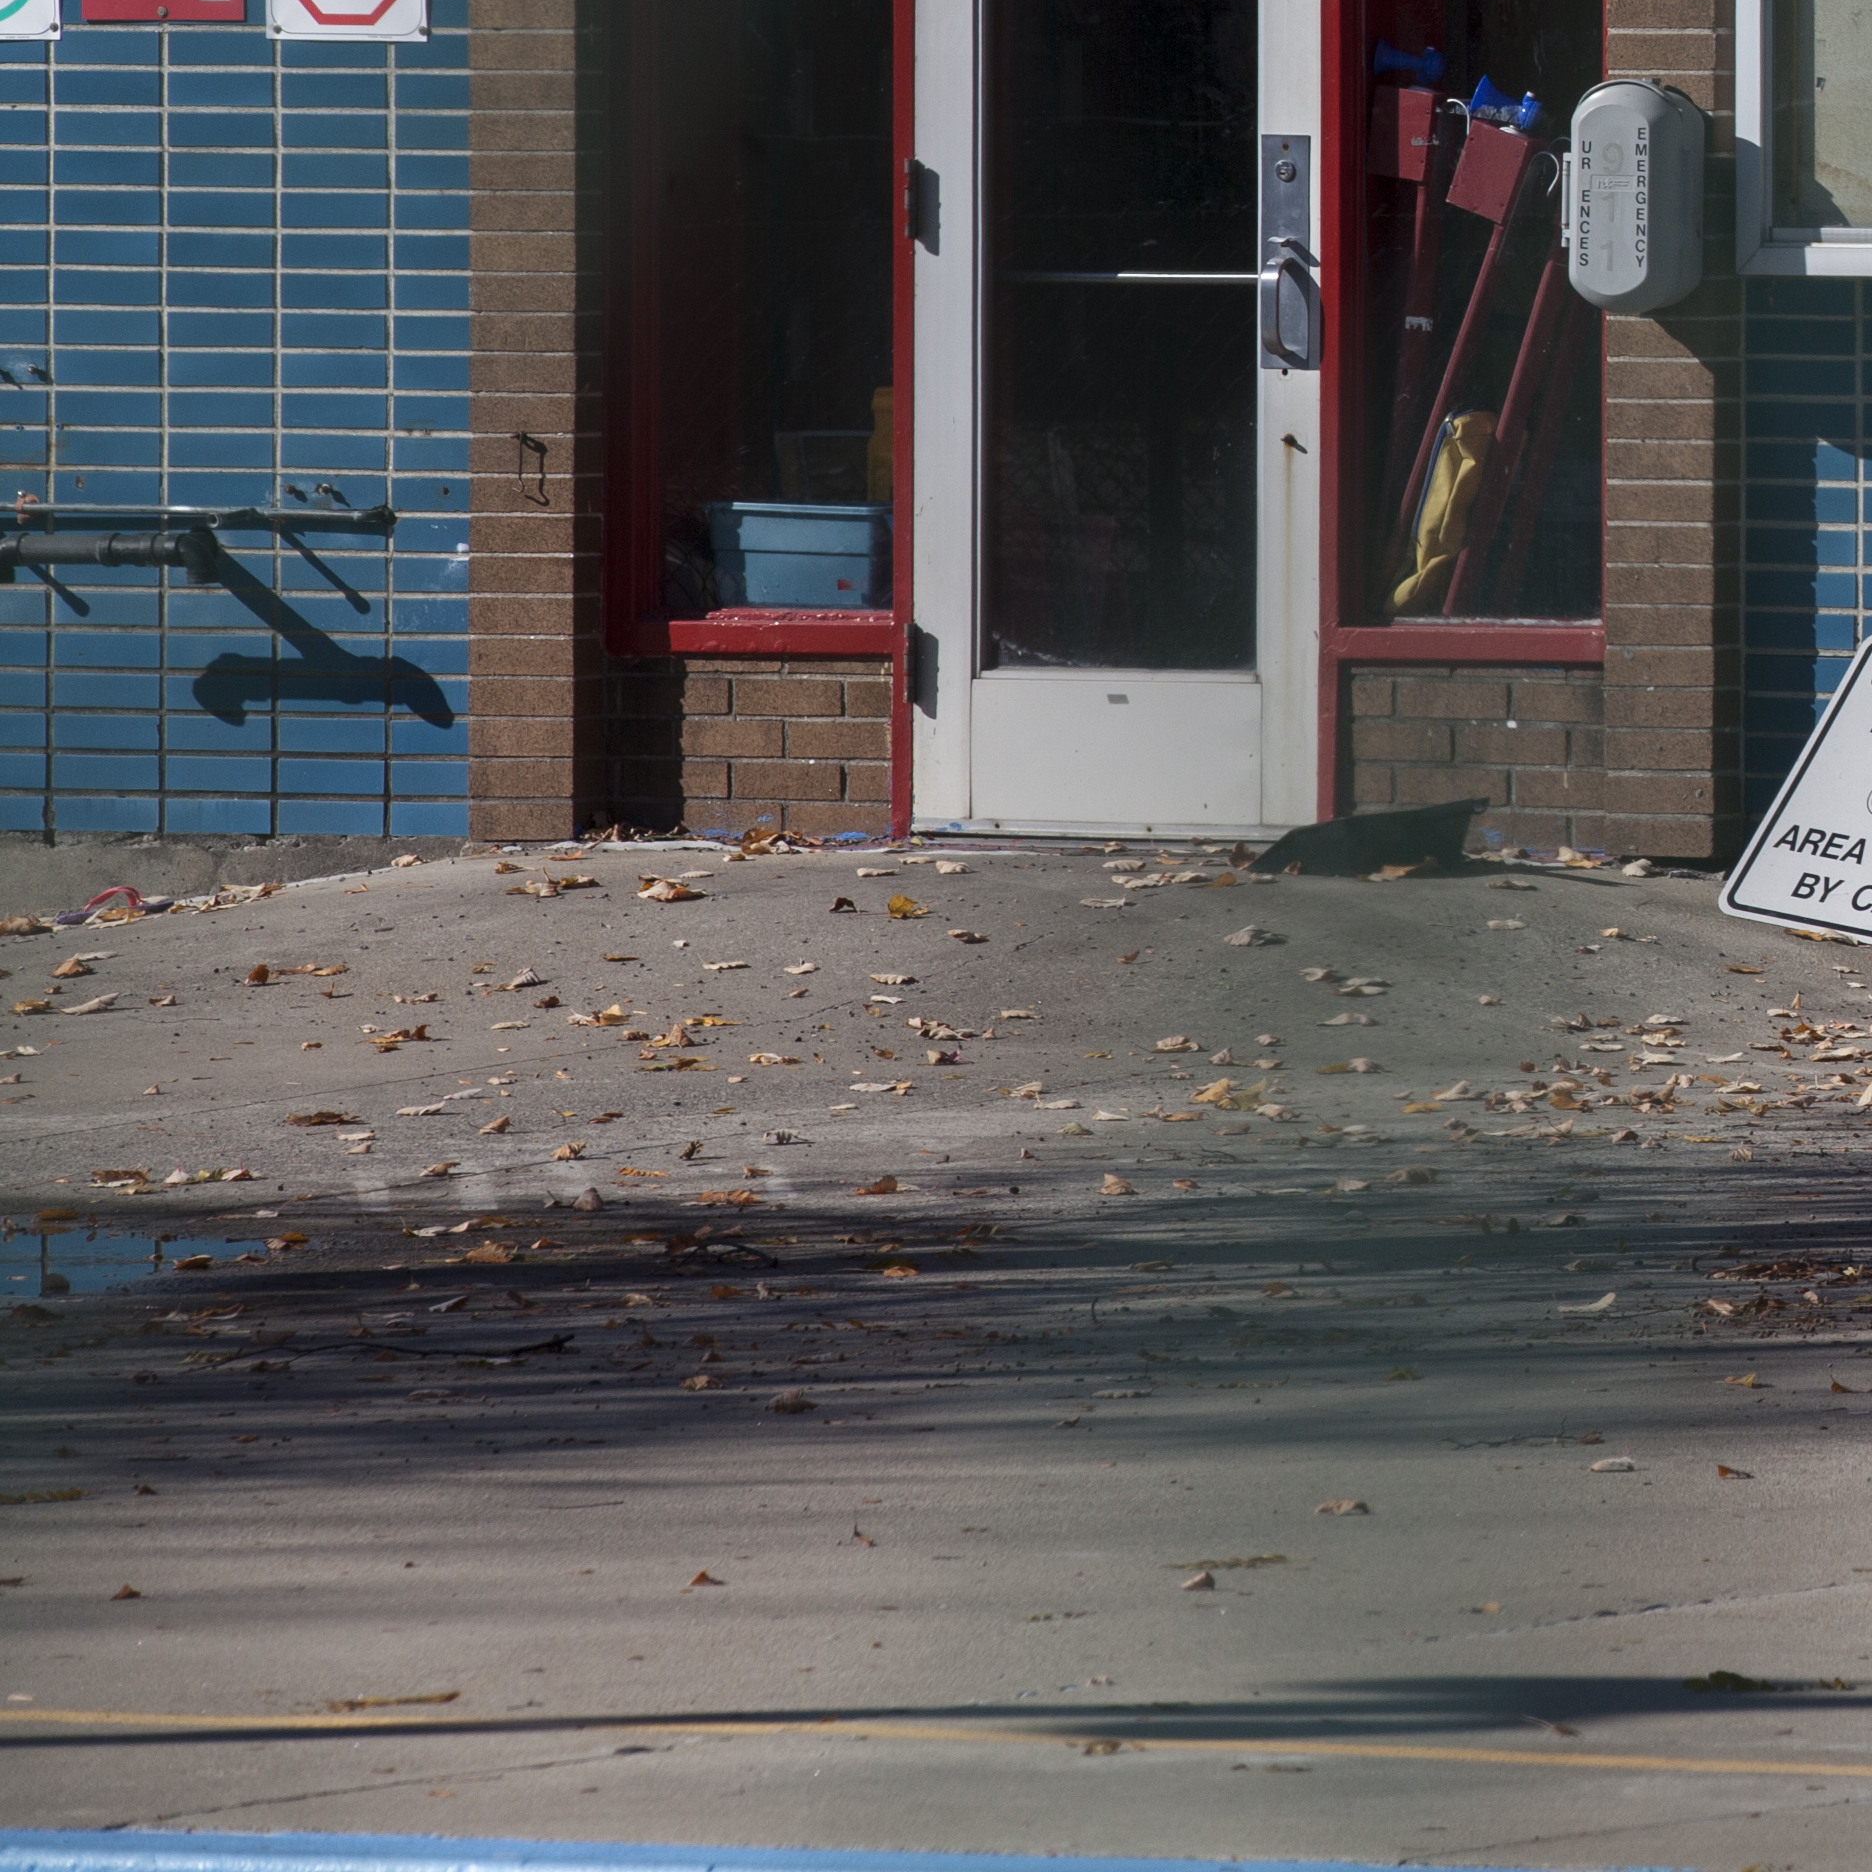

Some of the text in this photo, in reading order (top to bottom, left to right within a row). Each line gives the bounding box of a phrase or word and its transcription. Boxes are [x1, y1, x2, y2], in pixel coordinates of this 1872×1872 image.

[1635, 128, 1647, 268] EMERGENCY
[1773, 824, 1866, 866] AREA
[1790, 873, 1844, 904] BY
